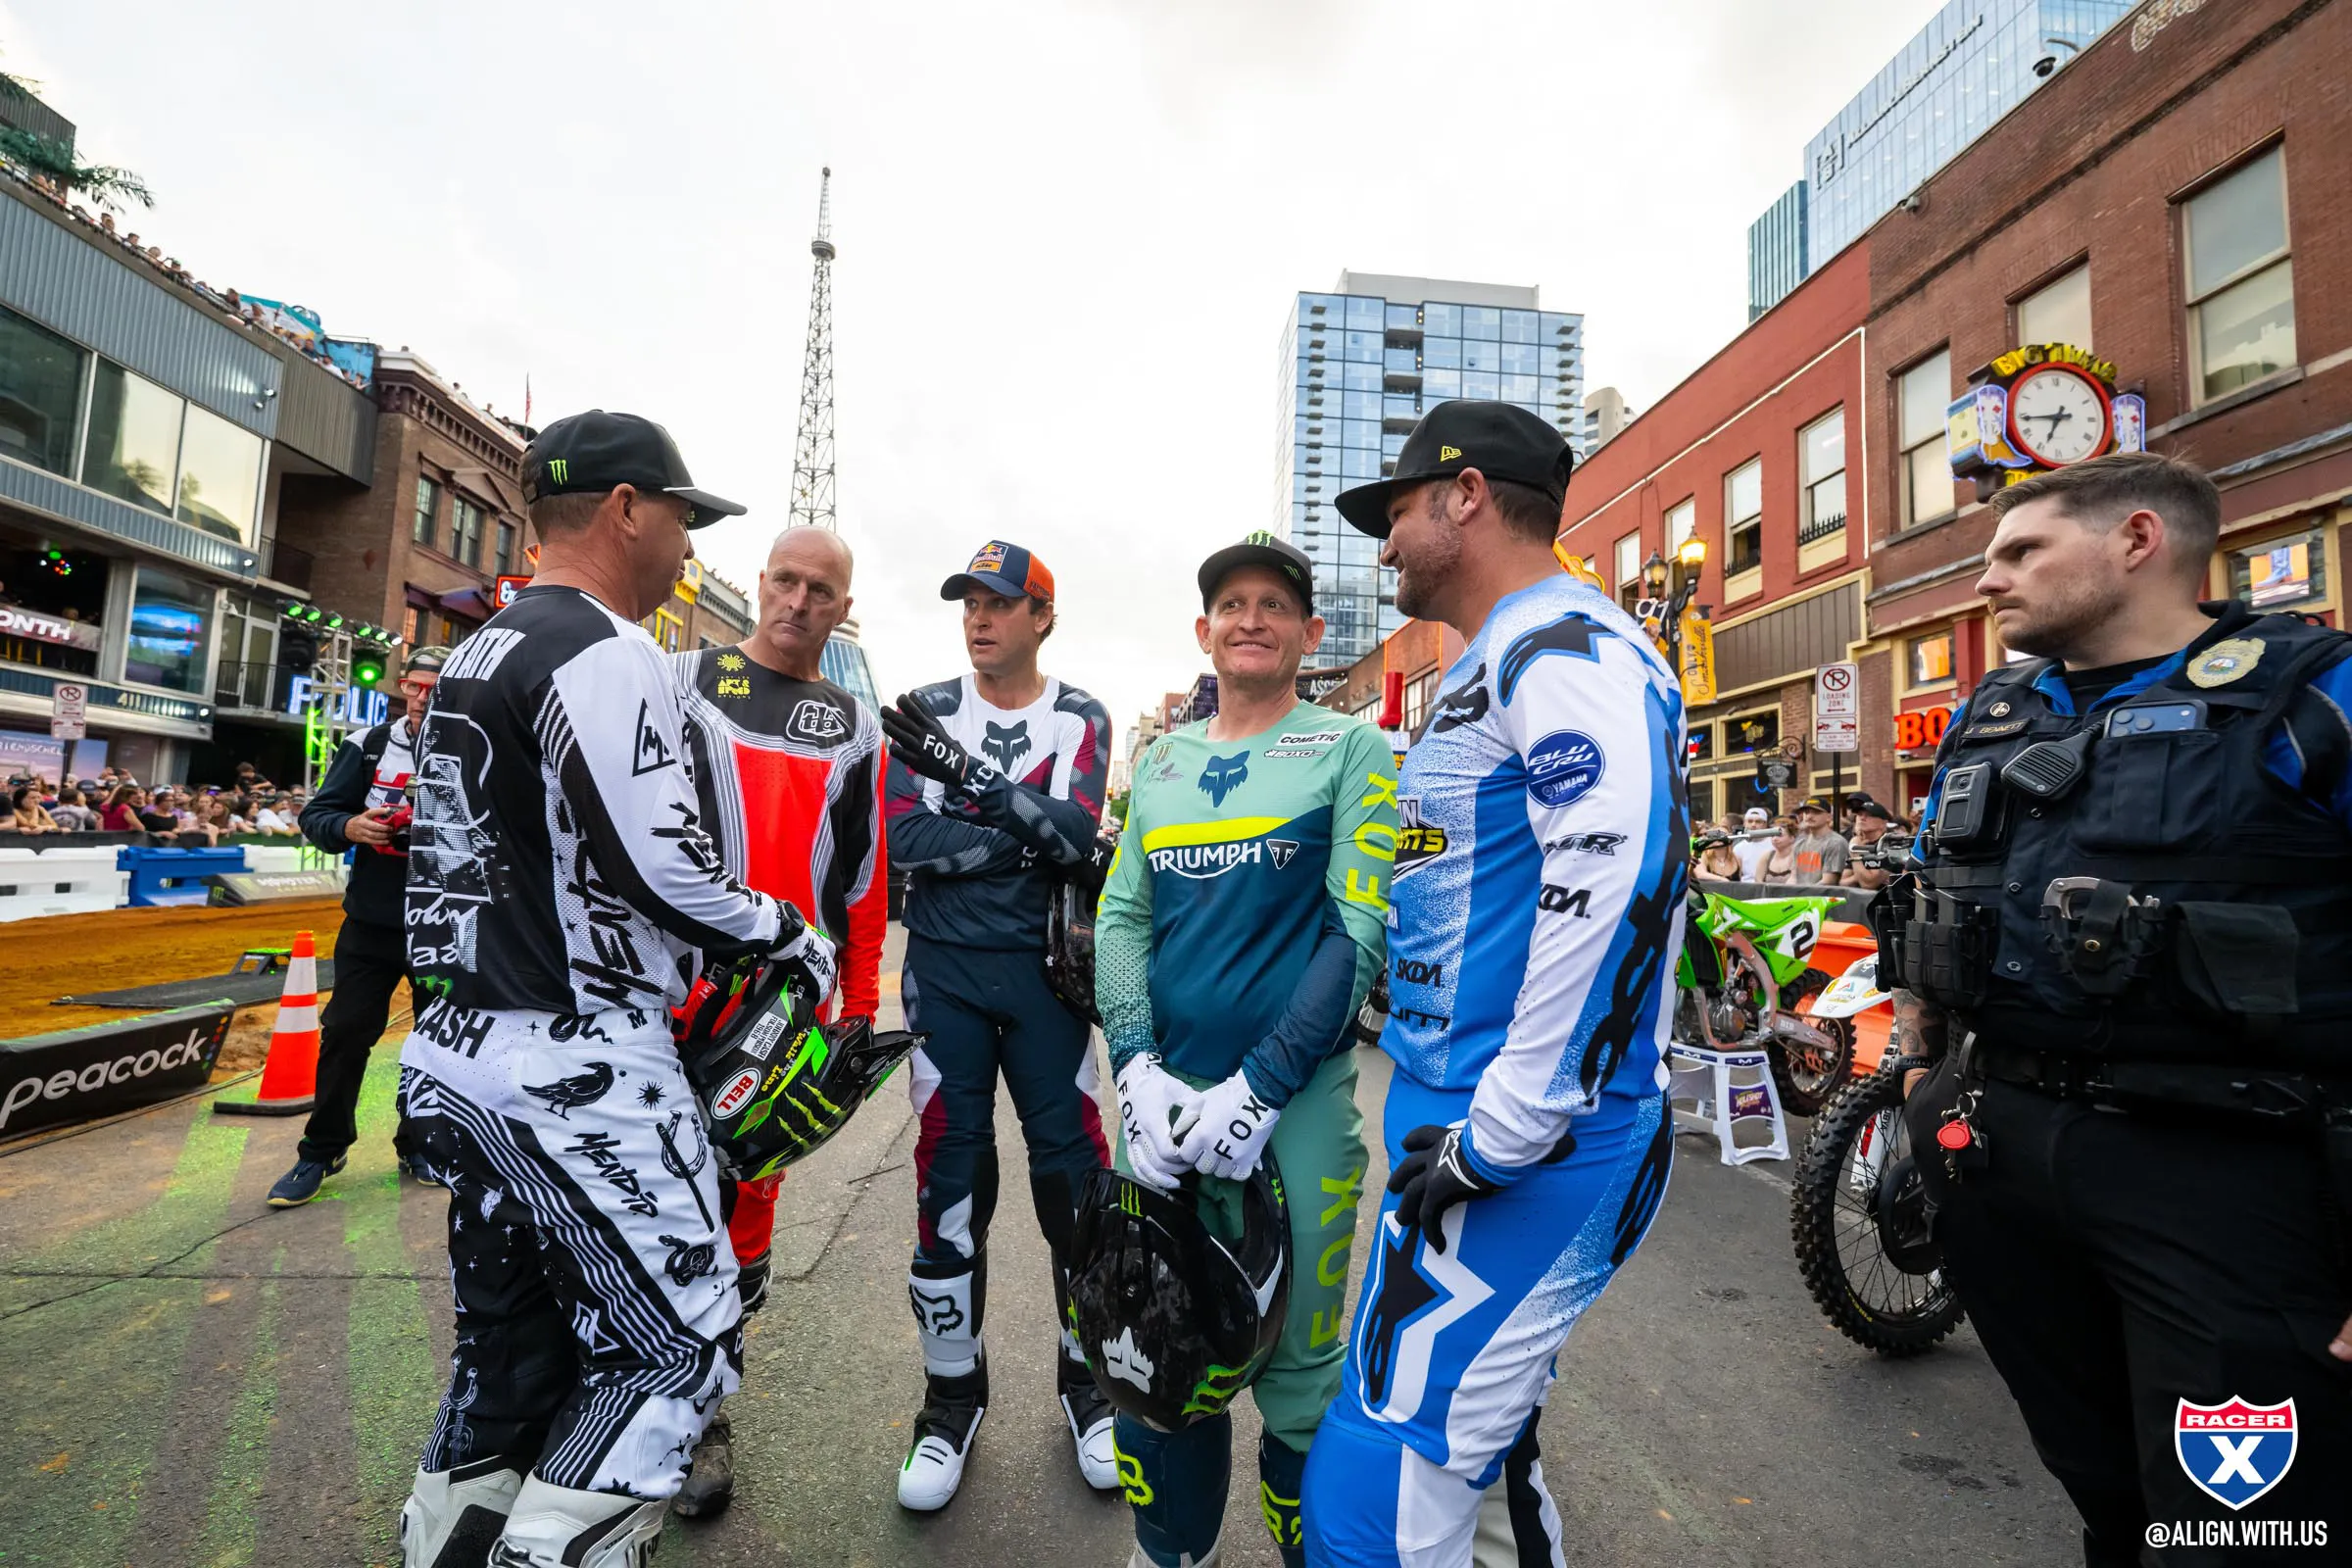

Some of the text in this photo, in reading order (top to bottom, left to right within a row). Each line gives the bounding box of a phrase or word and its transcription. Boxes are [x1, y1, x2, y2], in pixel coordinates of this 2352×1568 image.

[118, 692, 140, 707] 411
[1280, 733, 1340, 744] COMETIC
[1980, 721, 2026, 733] BENNETT
[923, 733, 960, 769] FOX
[1529, 744, 1589, 766] BLU
[1533, 753, 1594, 775] CRU
[1346, 770, 1400, 913] FOX
[1149, 842, 1262, 874] TRIUMPH
[1790, 921, 1814, 959] 2
[1396, 957, 1445, 988] SKDA
[414, 996, 495, 1059] CASH
[751, 1024, 764, 1039] 1968
[758, 1042, 771, 1058] CASH
[786, 1033, 806, 1058] Walk
[1, 1028, 208, 1129] peacock
[717, 1075, 754, 1111] BELL
[1117, 1080, 1142, 1143] FOX
[1213, 1093, 1270, 1160] FOX
[1309, 1166, 1362, 1349] FOX
